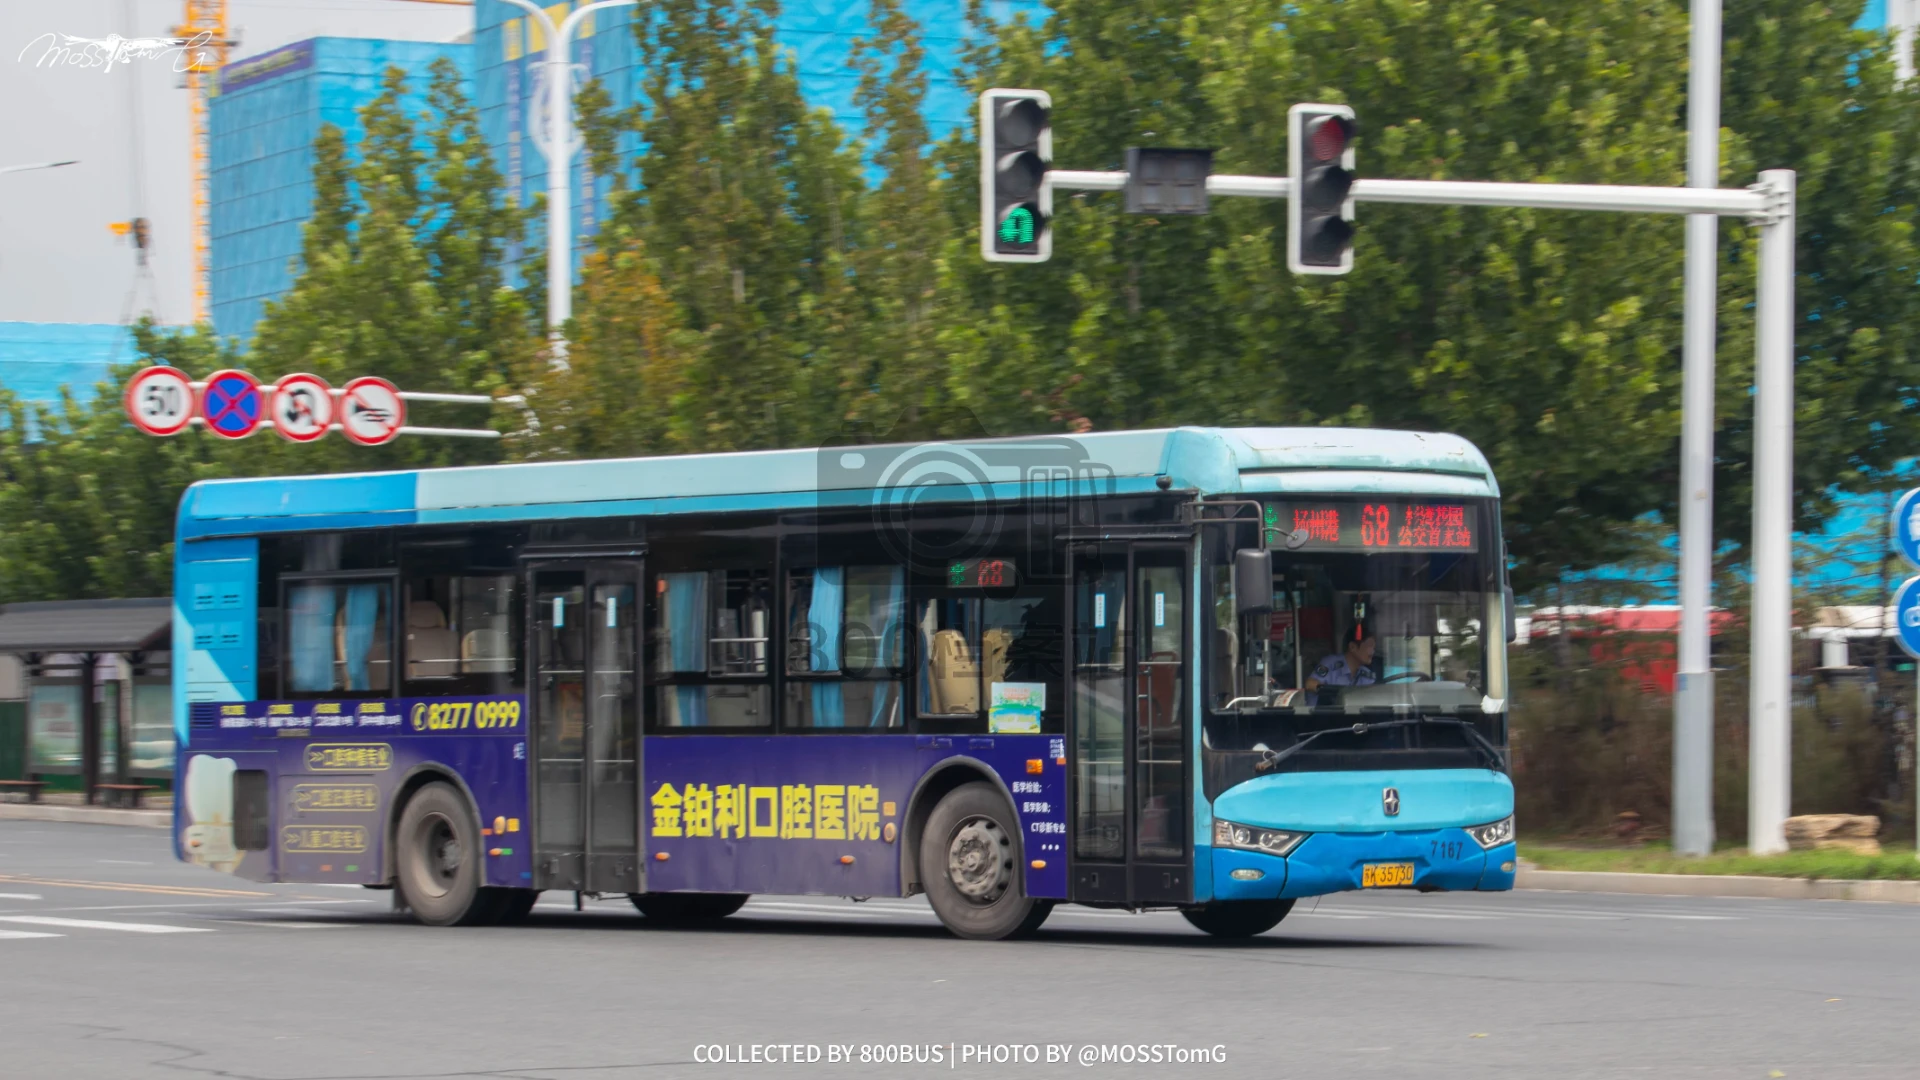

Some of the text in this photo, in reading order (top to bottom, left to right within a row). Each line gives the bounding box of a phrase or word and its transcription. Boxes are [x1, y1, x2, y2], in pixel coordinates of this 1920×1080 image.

[143, 385, 181, 416] 50
[1360, 504, 1391, 546] 68
[1398, 525, 1472, 547] 公交首末站
[977, 559, 1004, 587] 68
[428, 702, 474, 730] 8277
[474, 700, 521, 729] 0999
[650, 782, 881, 841] 金铂利口腔医院
[1431, 839, 1464, 861] 7167
